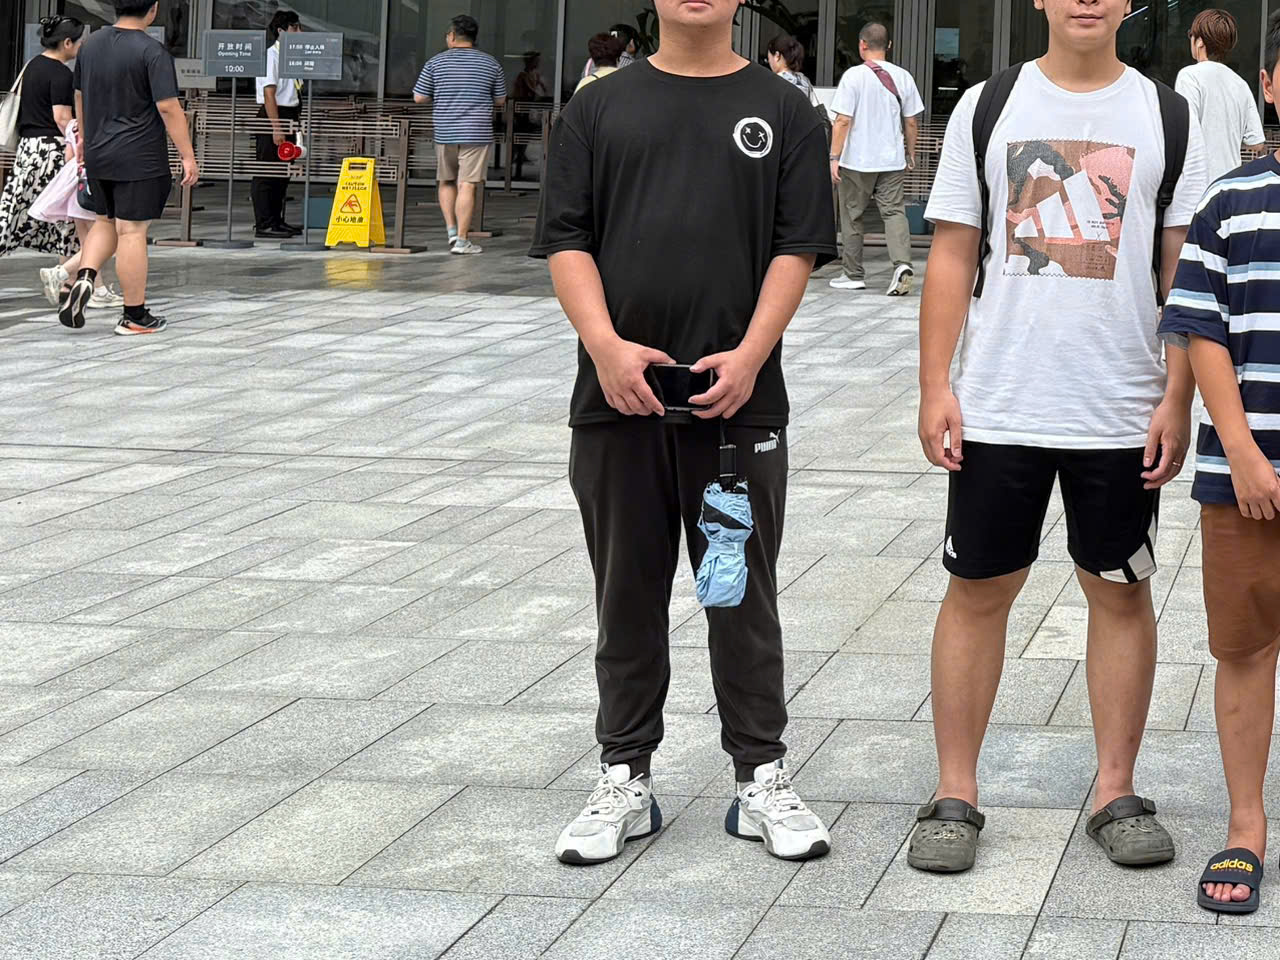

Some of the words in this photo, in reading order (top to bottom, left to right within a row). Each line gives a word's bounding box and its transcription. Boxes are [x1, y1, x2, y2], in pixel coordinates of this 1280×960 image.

[217, 42, 252, 51] 开放时间
[224, 65, 245, 73] 10:00
[335, 216, 364, 224] 小心地滑
[1210, 858, 1255, 873] adidas
